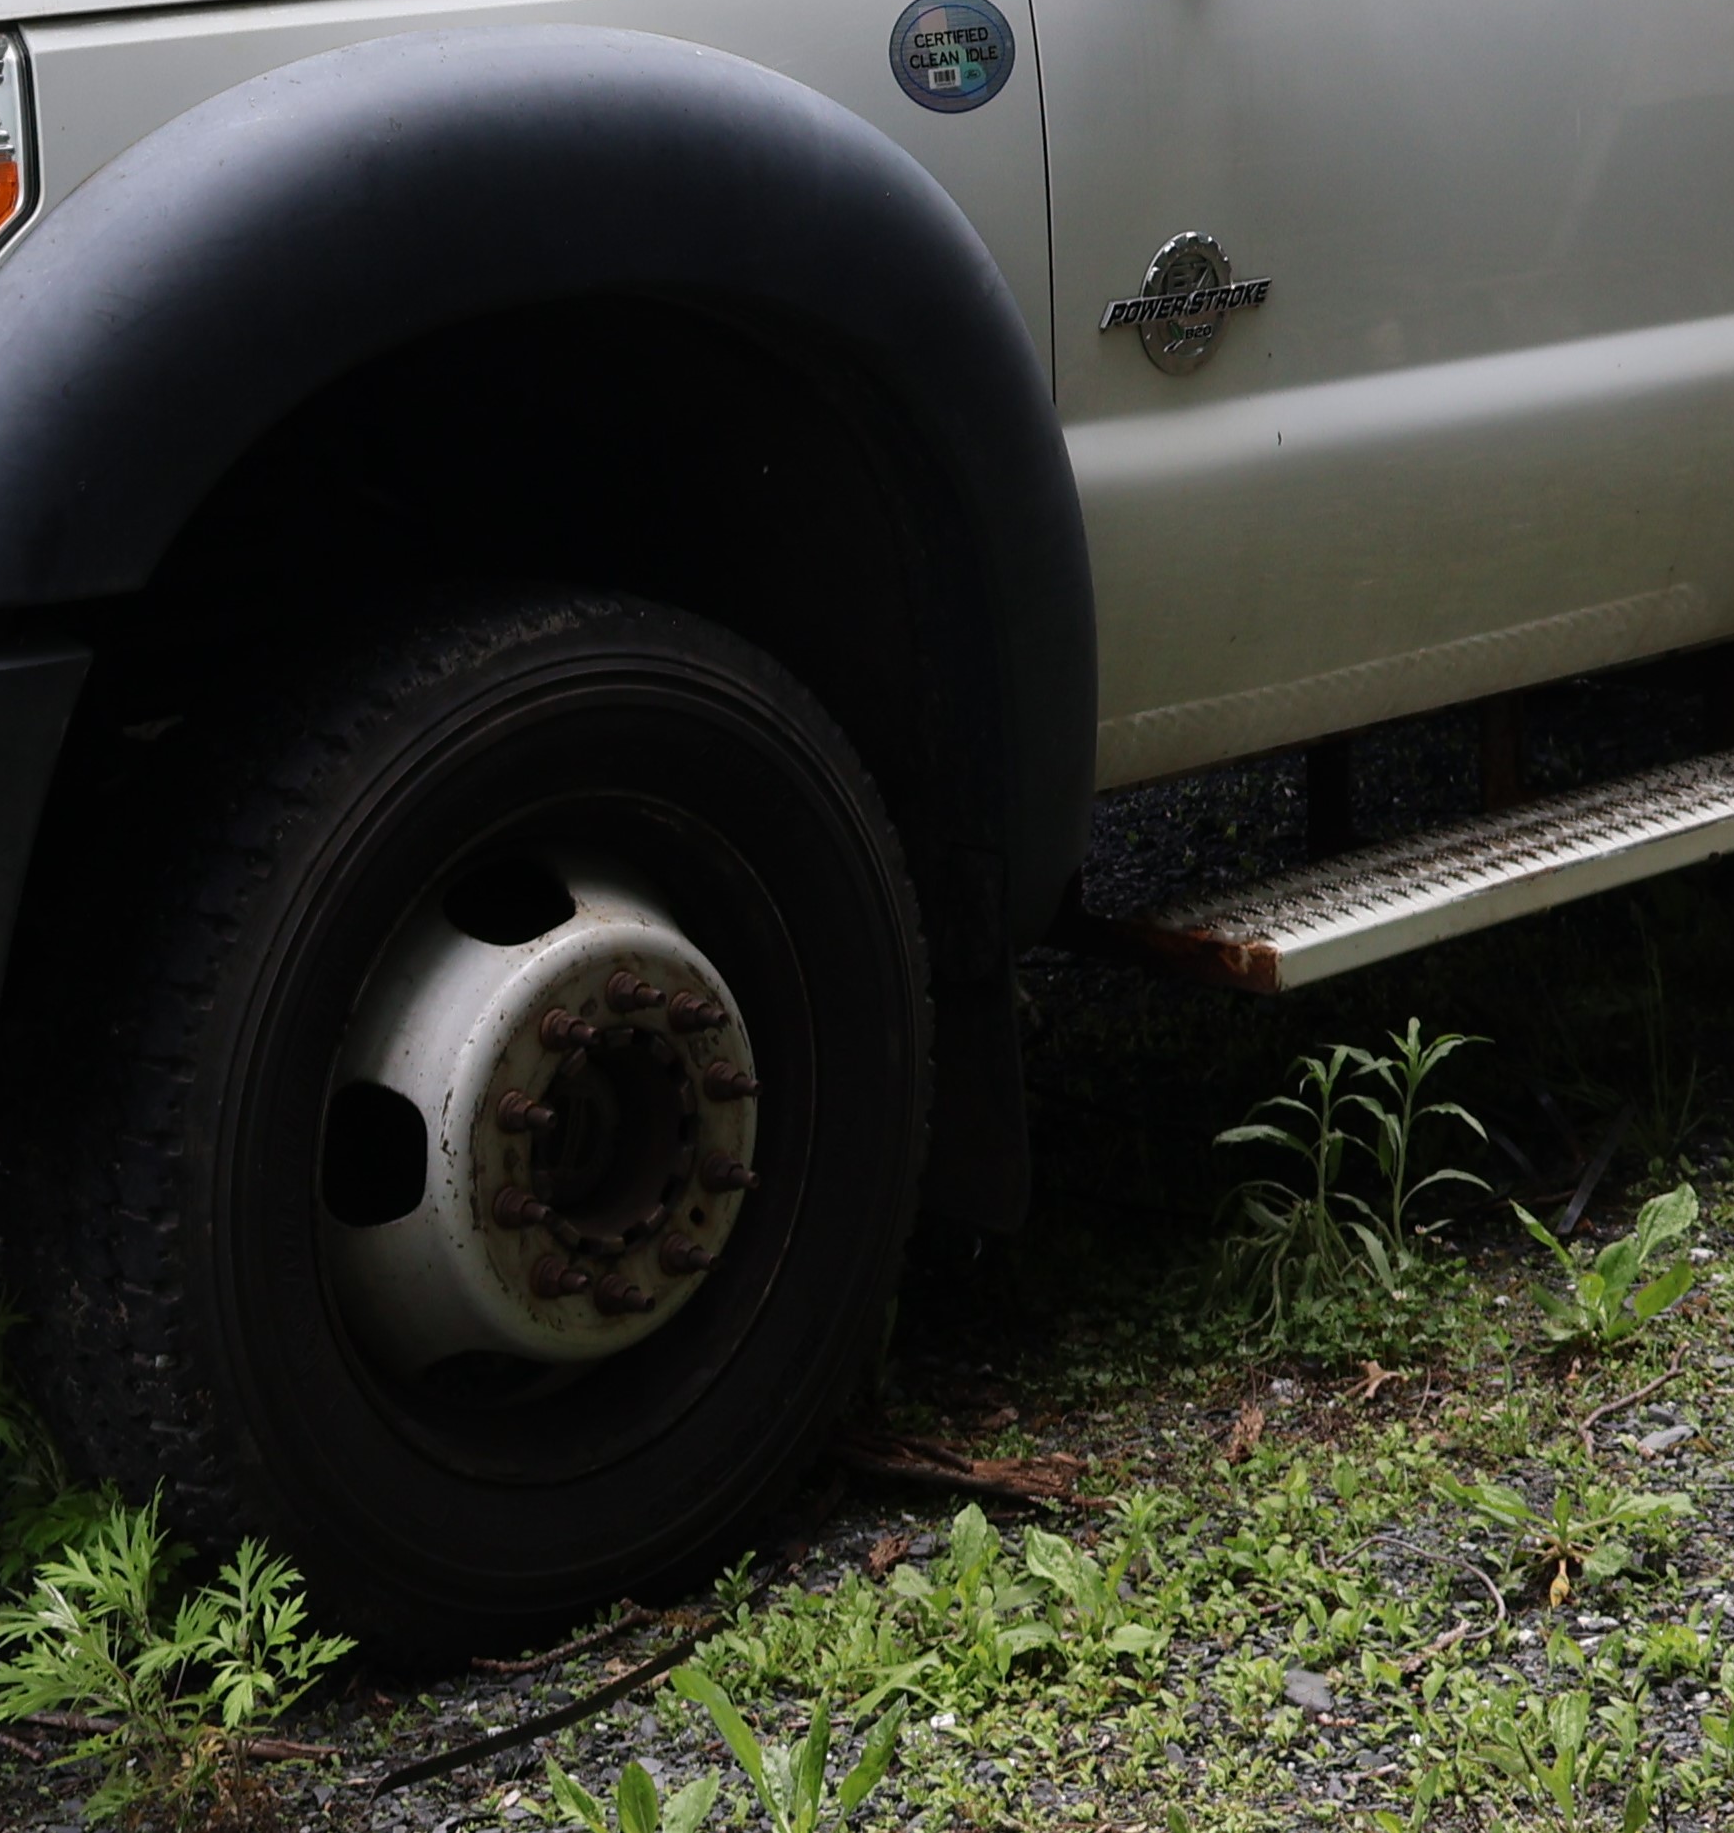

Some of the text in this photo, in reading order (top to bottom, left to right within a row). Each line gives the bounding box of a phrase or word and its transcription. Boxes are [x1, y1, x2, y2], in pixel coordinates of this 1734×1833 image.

[914, 26, 989, 47] CERTIFIED
[909, 45, 999, 70] CLEAN IDLE
[1184, 324, 1212, 340] B20
